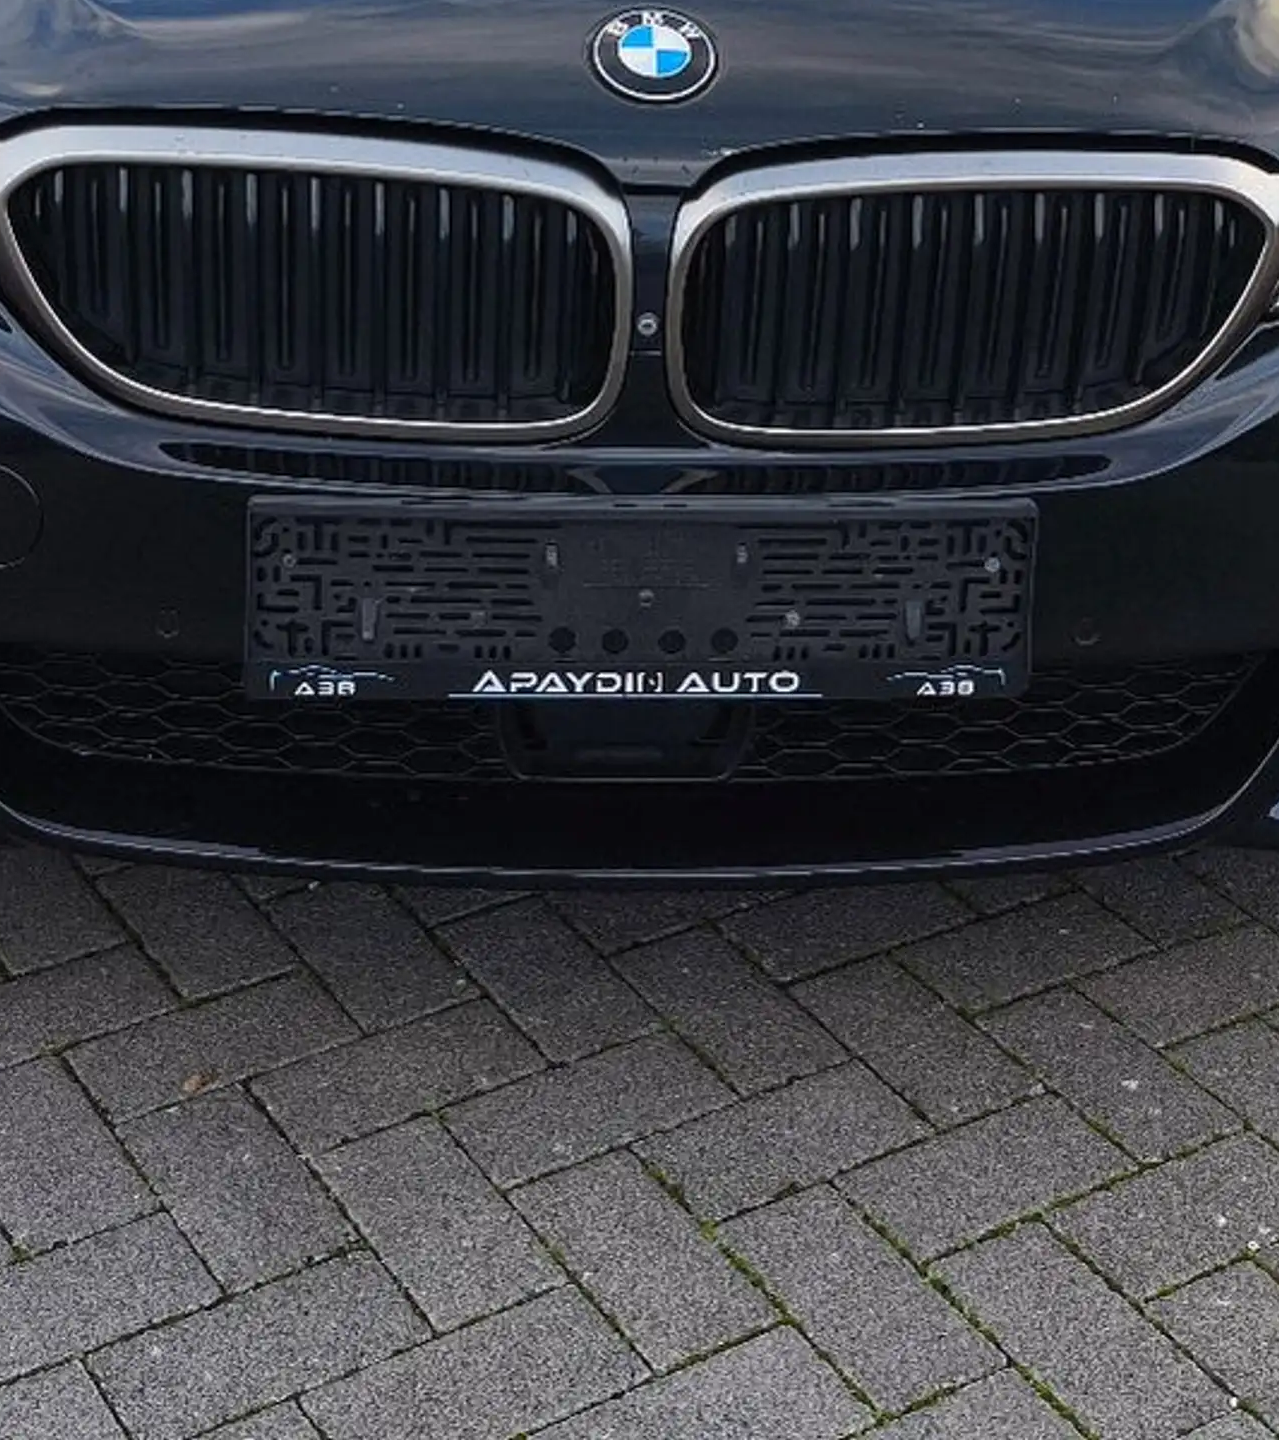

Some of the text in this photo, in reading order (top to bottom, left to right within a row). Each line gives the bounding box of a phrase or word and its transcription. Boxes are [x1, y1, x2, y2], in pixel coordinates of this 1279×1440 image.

[606, 10, 701, 38] BMW
[472, 670, 801, 694] APAYDIN AUTO
